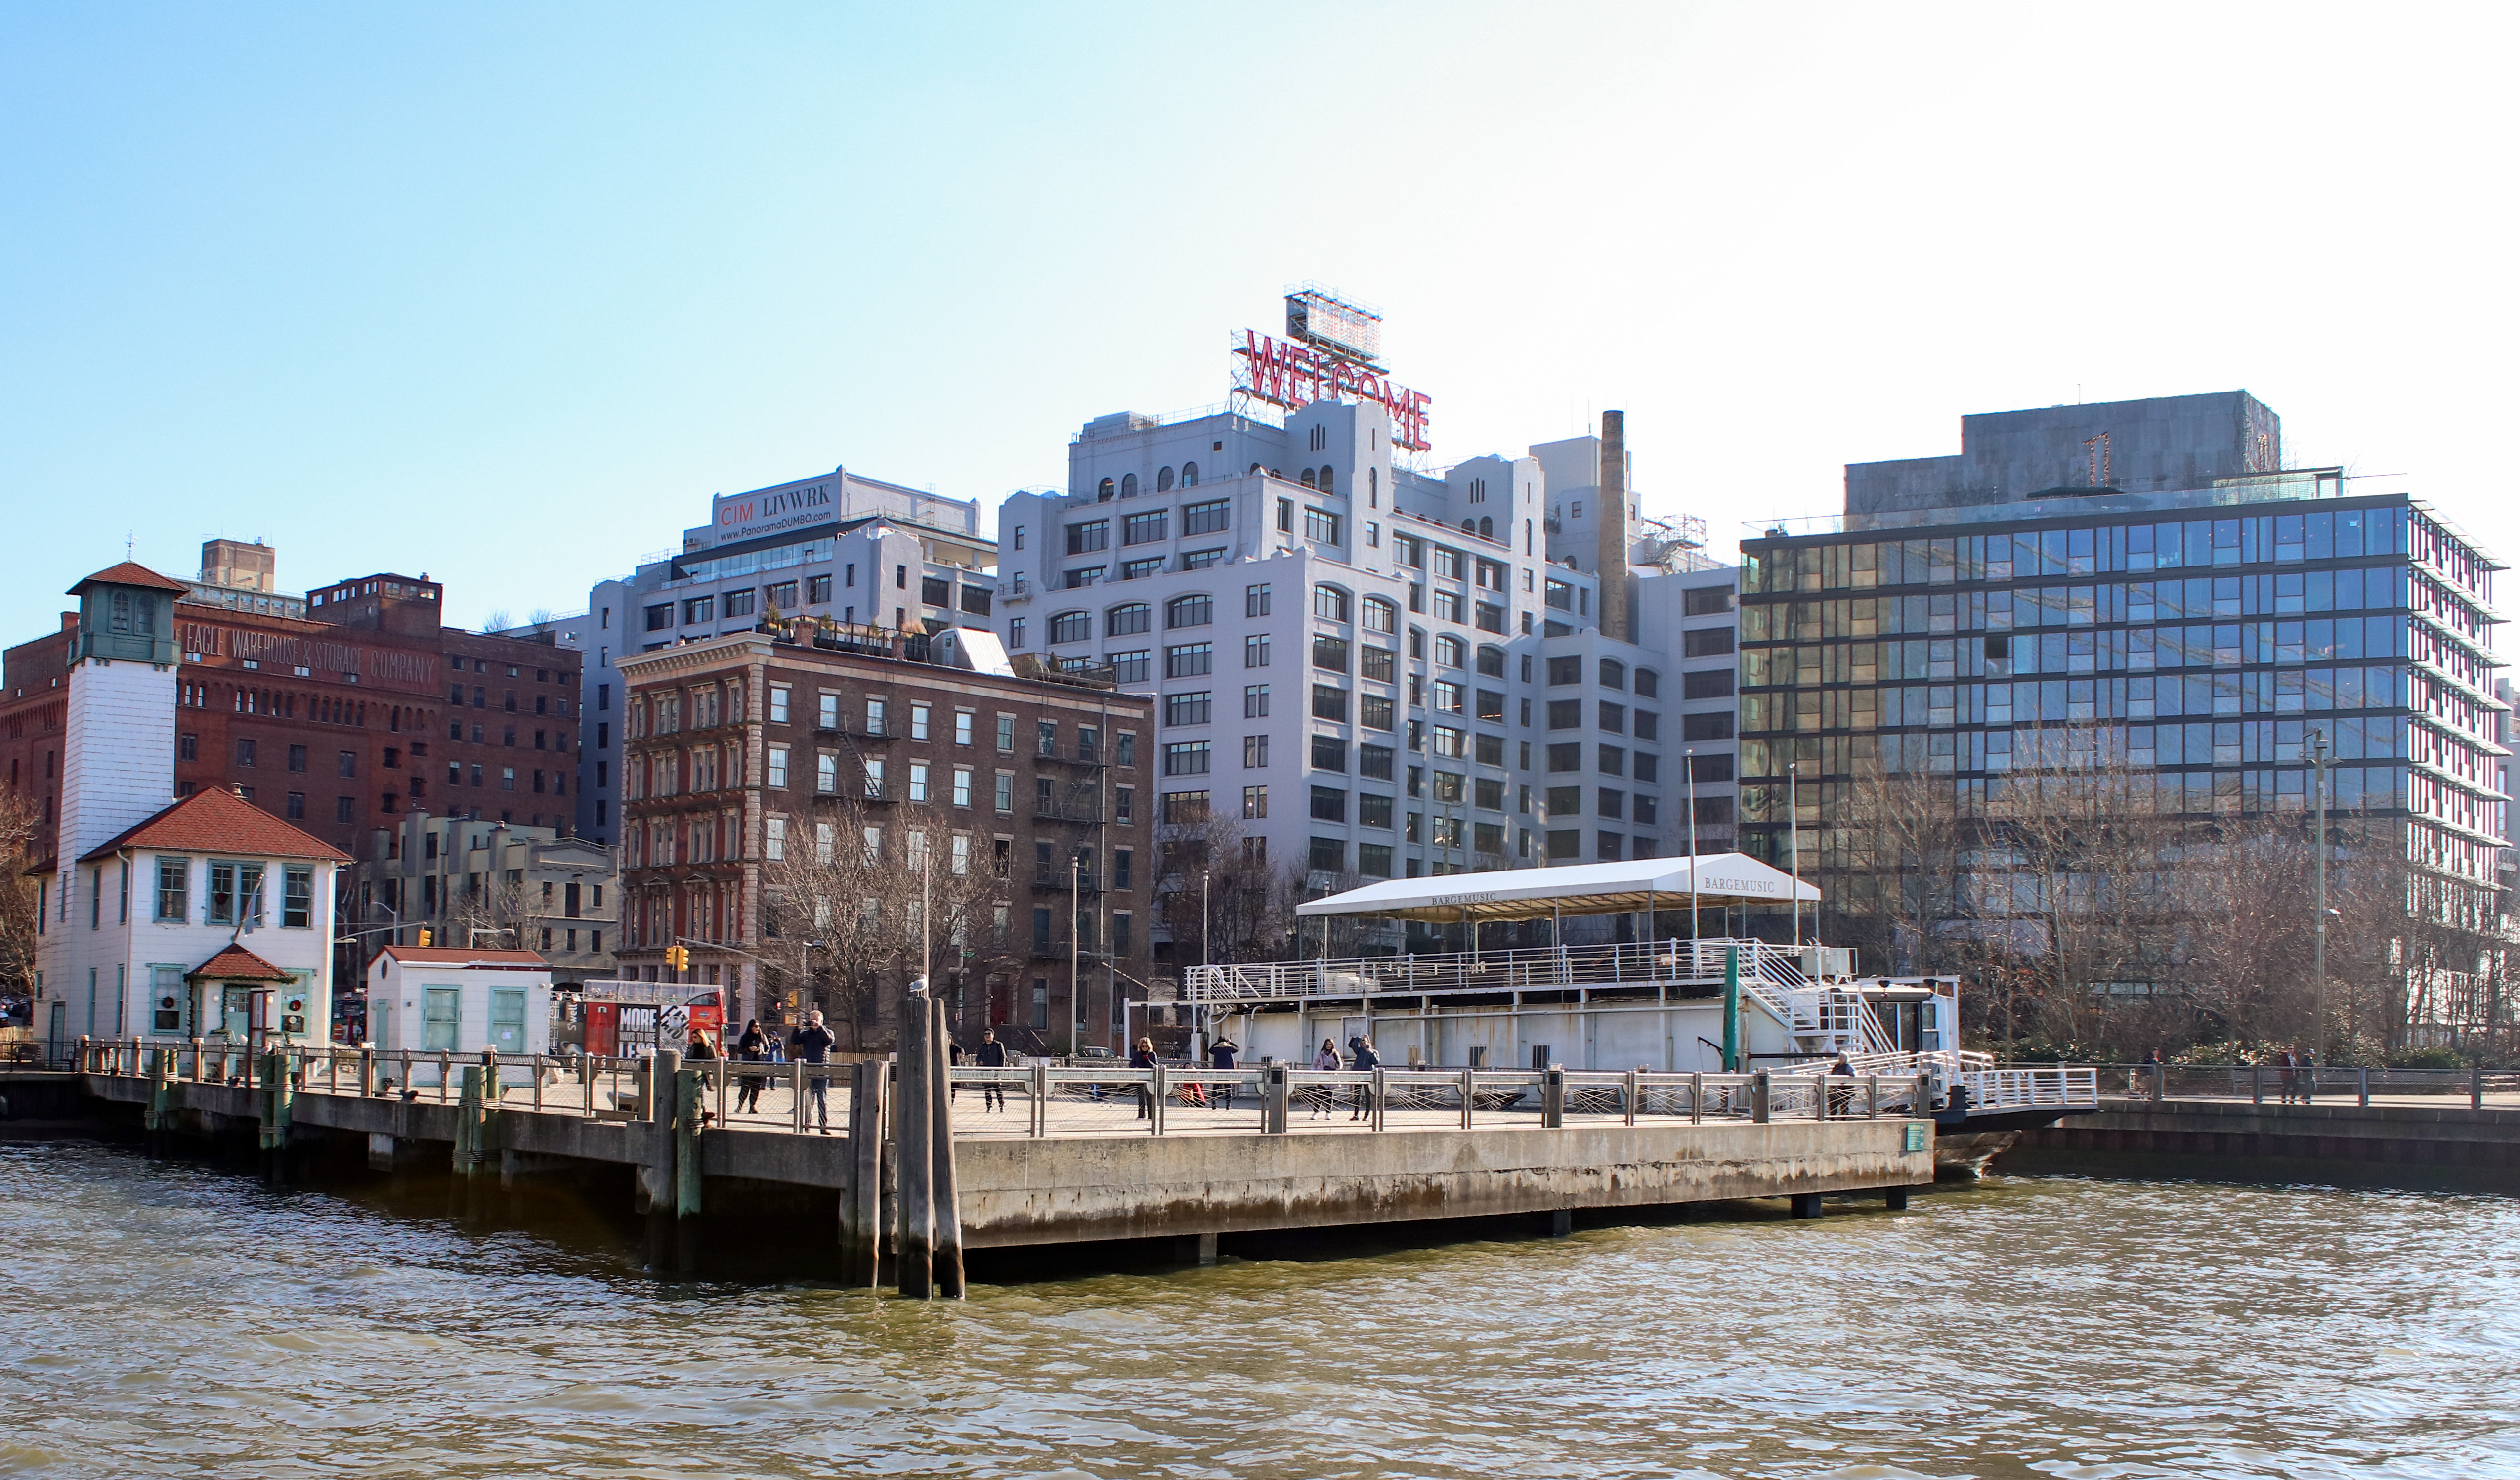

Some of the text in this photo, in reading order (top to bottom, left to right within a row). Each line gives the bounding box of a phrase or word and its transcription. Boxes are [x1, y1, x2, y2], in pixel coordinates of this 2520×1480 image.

[1247, 330, 1431, 450] WELCOME
[721, 484, 831, 525] CIM LIVWRK
[721, 511, 831, 541] www.PanoramaDUMBO.com
[187, 623, 223, 656] EAGLE
[232, 629, 299, 666] WAREHOUSE
[303, 641, 311, 667] &
[315, 642, 363, 675] STORAGE
[371, 651, 434, 685] COMPANY
[1704, 877, 1774, 893] BARGEMUSIC
[1432, 893, 1496, 905] BARGEMUSIC
[620, 1007, 657, 1032] MORE
[619, 1031, 656, 1042] WAYS TO USE
